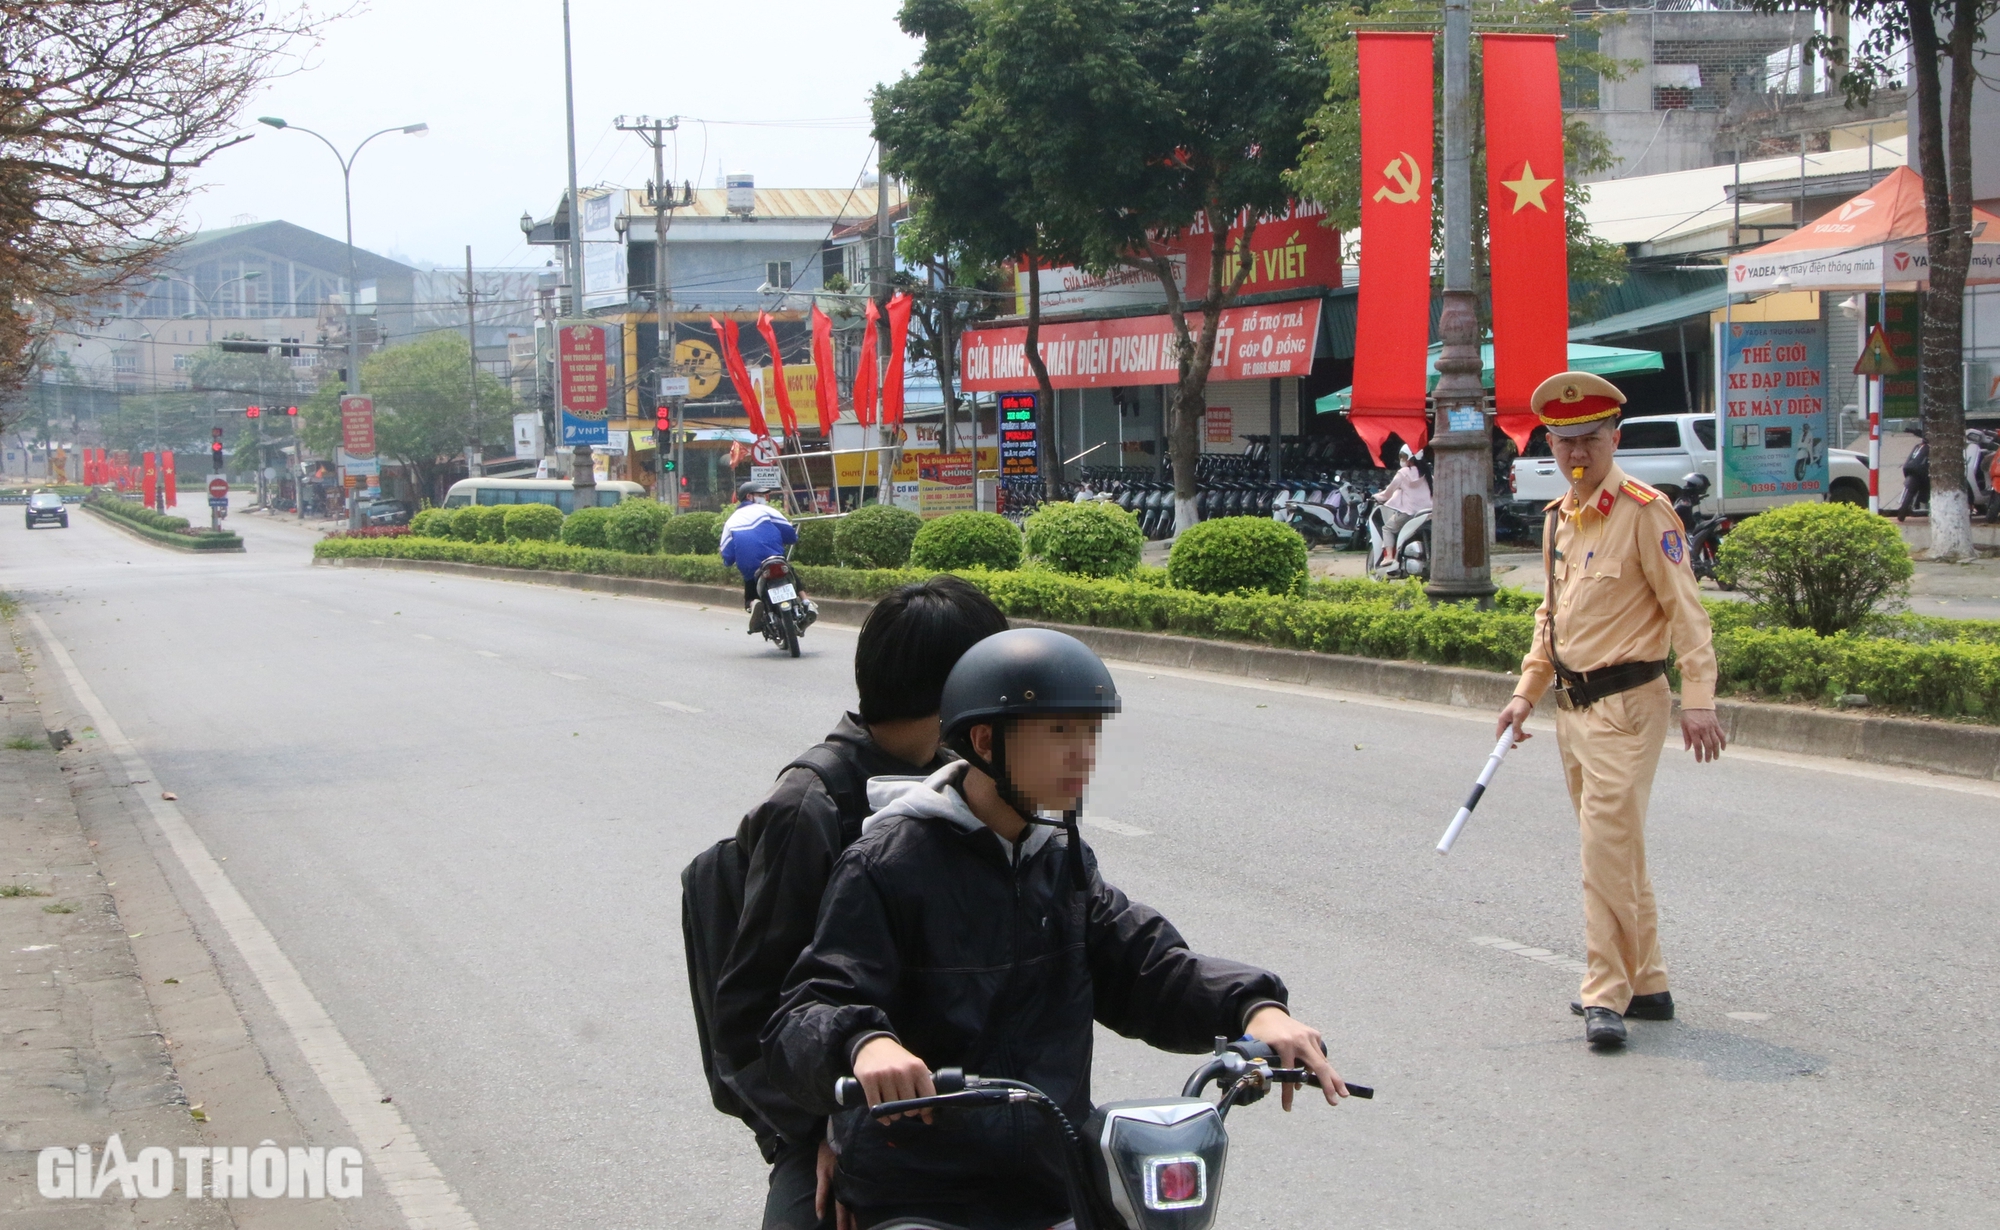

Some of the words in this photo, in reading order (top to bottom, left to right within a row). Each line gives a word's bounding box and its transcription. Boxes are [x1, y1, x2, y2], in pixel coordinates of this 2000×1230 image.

[1813, 223, 1856, 234] YADEA
[1262, 229, 1307, 282] VIẾT
[1748, 265, 1776, 279] YADEA
[1809, 260, 1826, 275] điện
[1828, 260, 1852, 275] thông
[1853, 259, 1875, 271] minh
[1242, 310, 1257, 332] HỖ
[1259, 312, 1281, 333] TRỢ
[1282, 306, 1304, 328] TRẢ
[1745, 328, 1768, 336] YADEA
[1769, 327, 1793, 336] TRUNG
[1239, 340, 1260, 359] GÓP
[1261, 334, 1273, 358] 0
[1275, 333, 1306, 355] ĐỒNG
[1742, 339, 1772, 364] THẾ
[1775, 340, 1807, 363] GIỚI
[967, 335, 990, 380] CỬA
[993, 337, 1025, 379] HÀNG
[1046, 333, 1076, 376] MÁY
[1077, 330, 1109, 383] ĐIỆN
[1111, 333, 1159, 374] PUSAN
[1728, 373, 1748, 390] XE
[1751, 371, 1782, 393] ĐẠP
[1785, 366, 1821, 391] ĐIỆN
[246, 406, 260, 418] 23
[1728, 401, 1748, 418] XE
[1751, 396, 1783, 418] MÁY
[1787, 394, 1823, 419] ĐIỆN
[577, 427, 606, 435] VNPT
[1005, 431, 1033, 441] PUSAN
[931, 456, 946, 465] Điện
[941, 467, 972, 477] KHỦNG
[1751, 483, 1776, 493] 0396
[1801, 480, 1820, 490] 890
